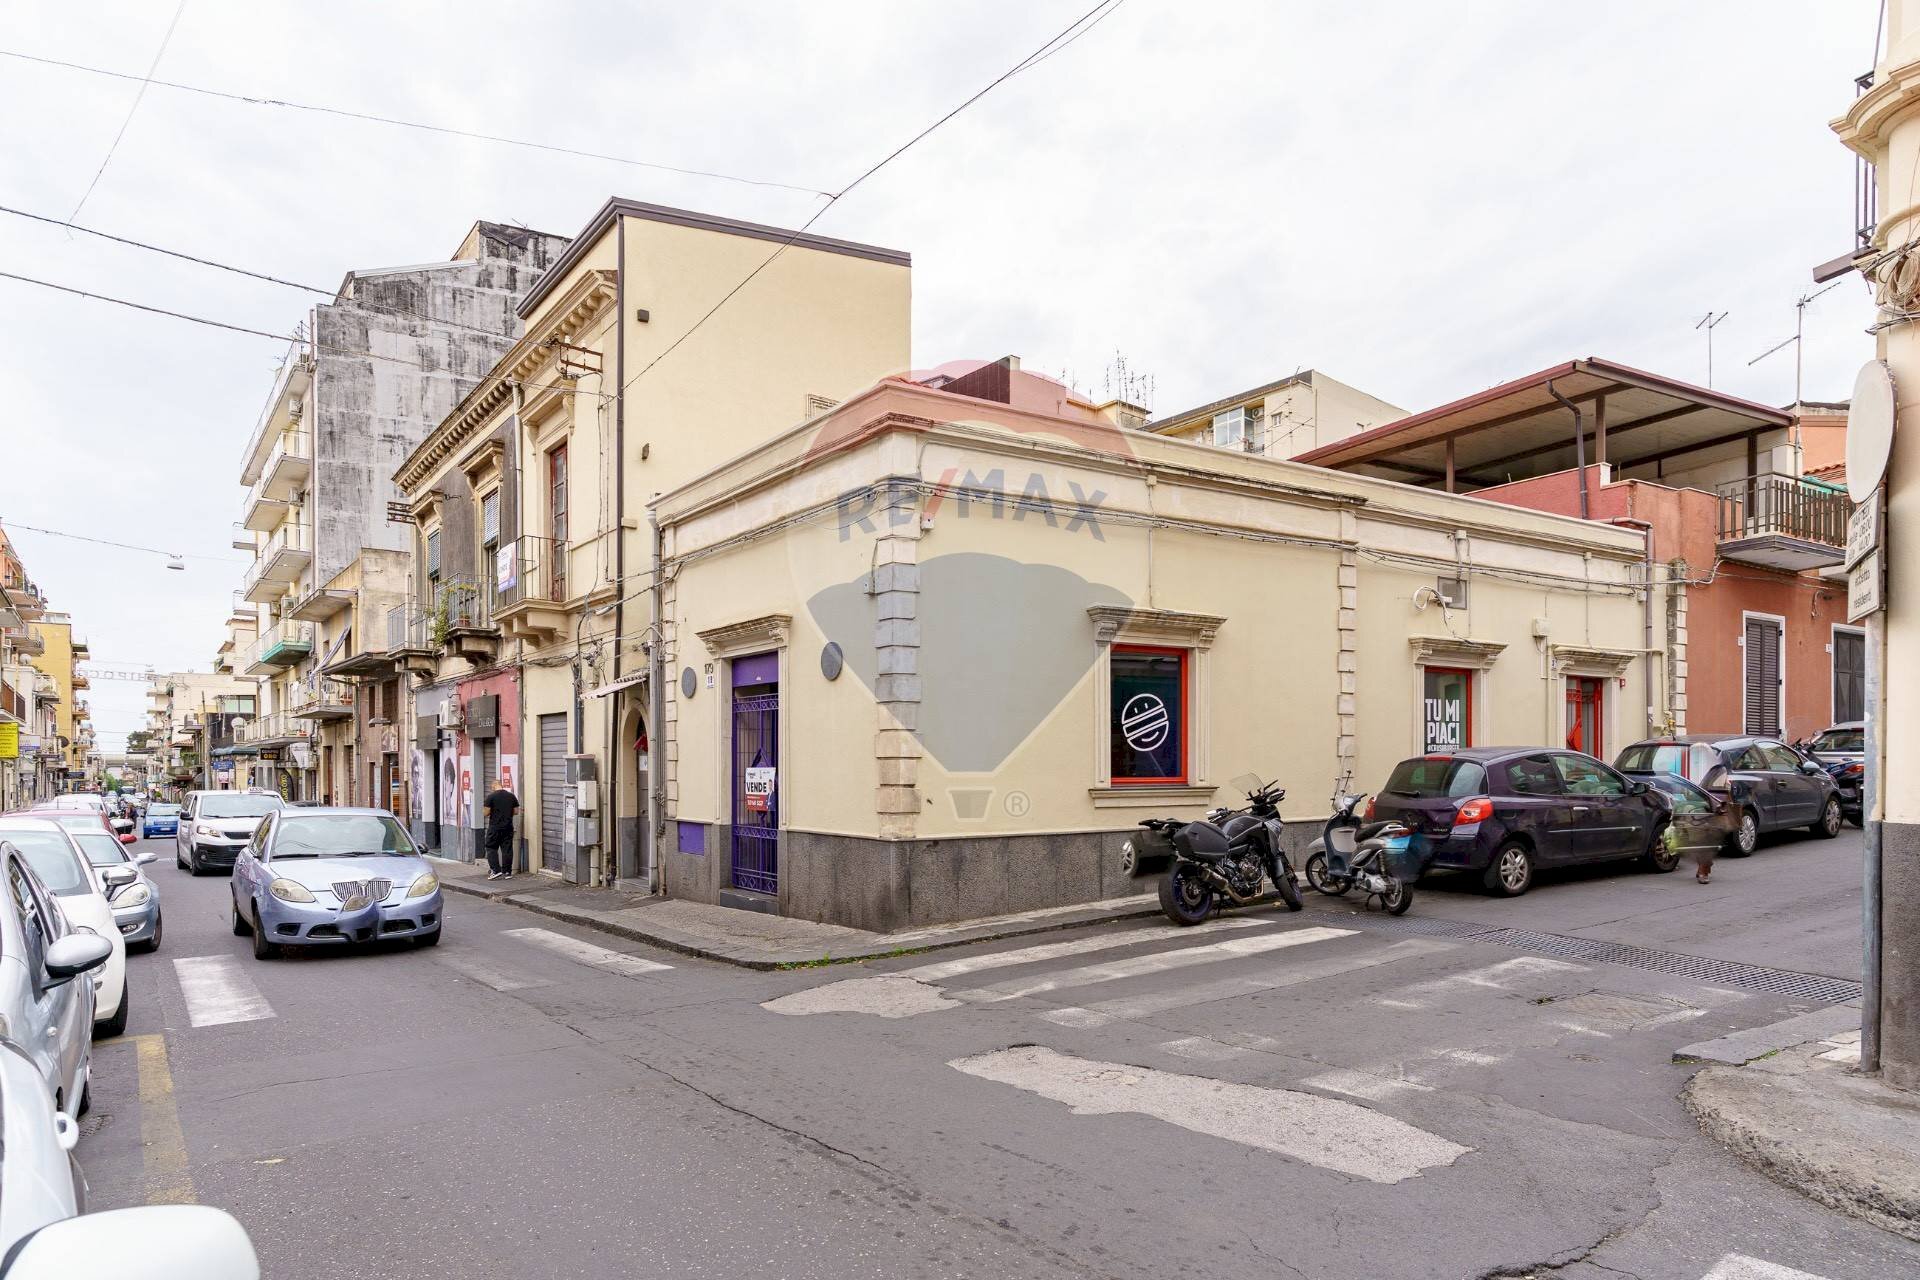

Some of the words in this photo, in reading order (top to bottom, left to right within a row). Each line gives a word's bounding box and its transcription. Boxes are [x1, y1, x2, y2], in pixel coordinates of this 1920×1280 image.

[1425, 698, 1441, 721] TU
[1445, 699, 1459, 721] MI
[1427, 722, 1459, 744] PIACI
[746, 781, 767, 793] VENDE
